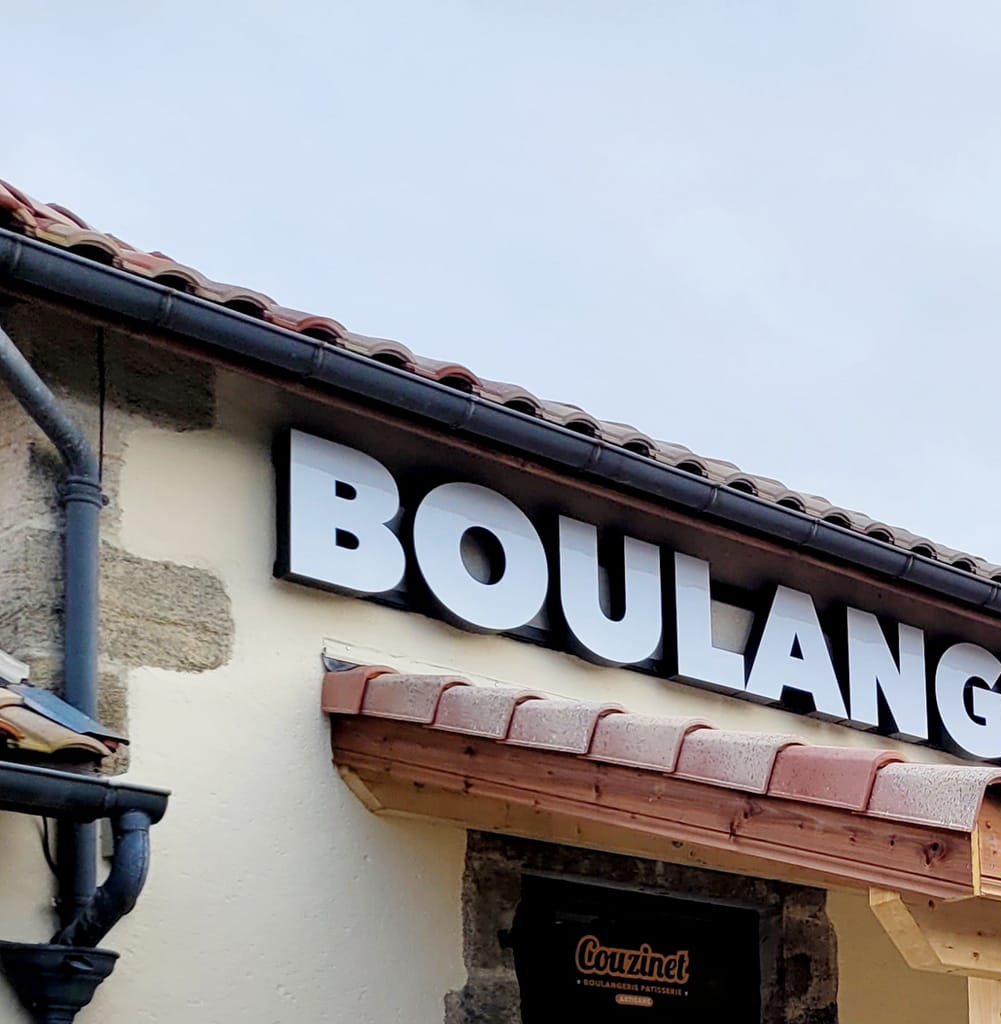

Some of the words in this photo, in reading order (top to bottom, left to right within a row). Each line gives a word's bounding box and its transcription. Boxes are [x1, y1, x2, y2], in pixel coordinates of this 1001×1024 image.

[576, 935, 690, 984] Couzinet
[583, 978, 639, 992] BOULANGERIE
[640, 984, 682, 996] PATISSERIE
